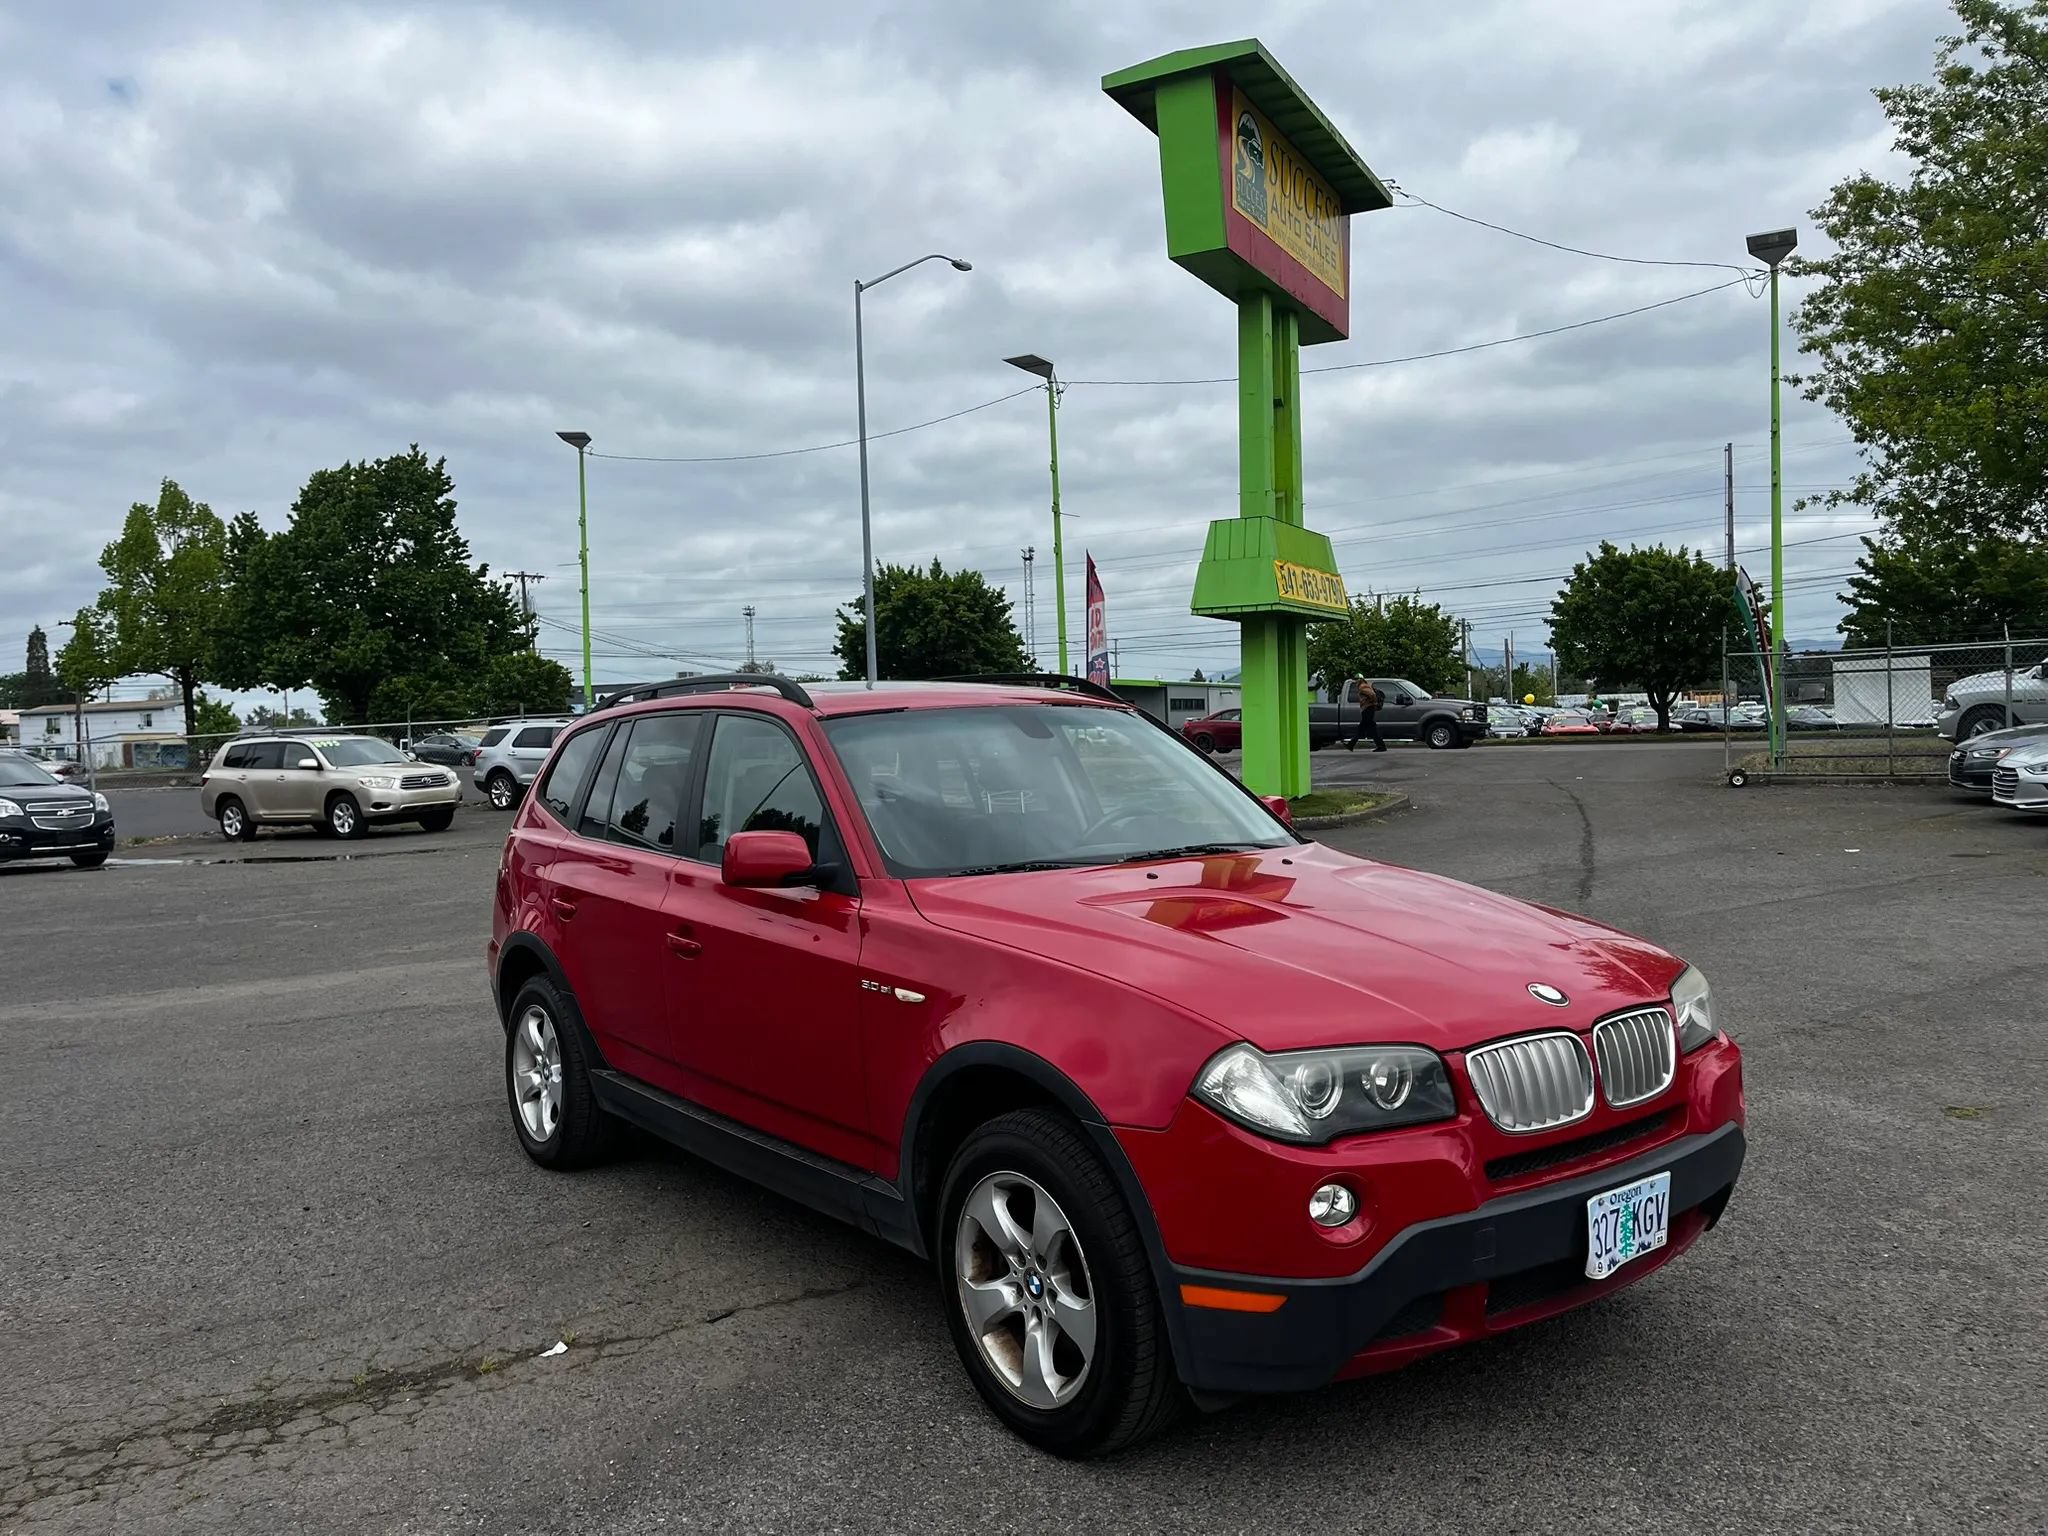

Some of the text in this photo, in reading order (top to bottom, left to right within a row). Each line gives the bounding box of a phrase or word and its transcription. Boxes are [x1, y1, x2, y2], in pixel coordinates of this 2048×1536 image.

[1236, 174, 1267, 214] SUCCESS
[1269, 141, 1340, 244] SUCCESS
[1271, 192, 1302, 239] AUTO
[1305, 221, 1337, 271] SALES
[1593, 1191, 1666, 1258] 327 KGV
[1610, 1186, 1642, 1203] Oregon
